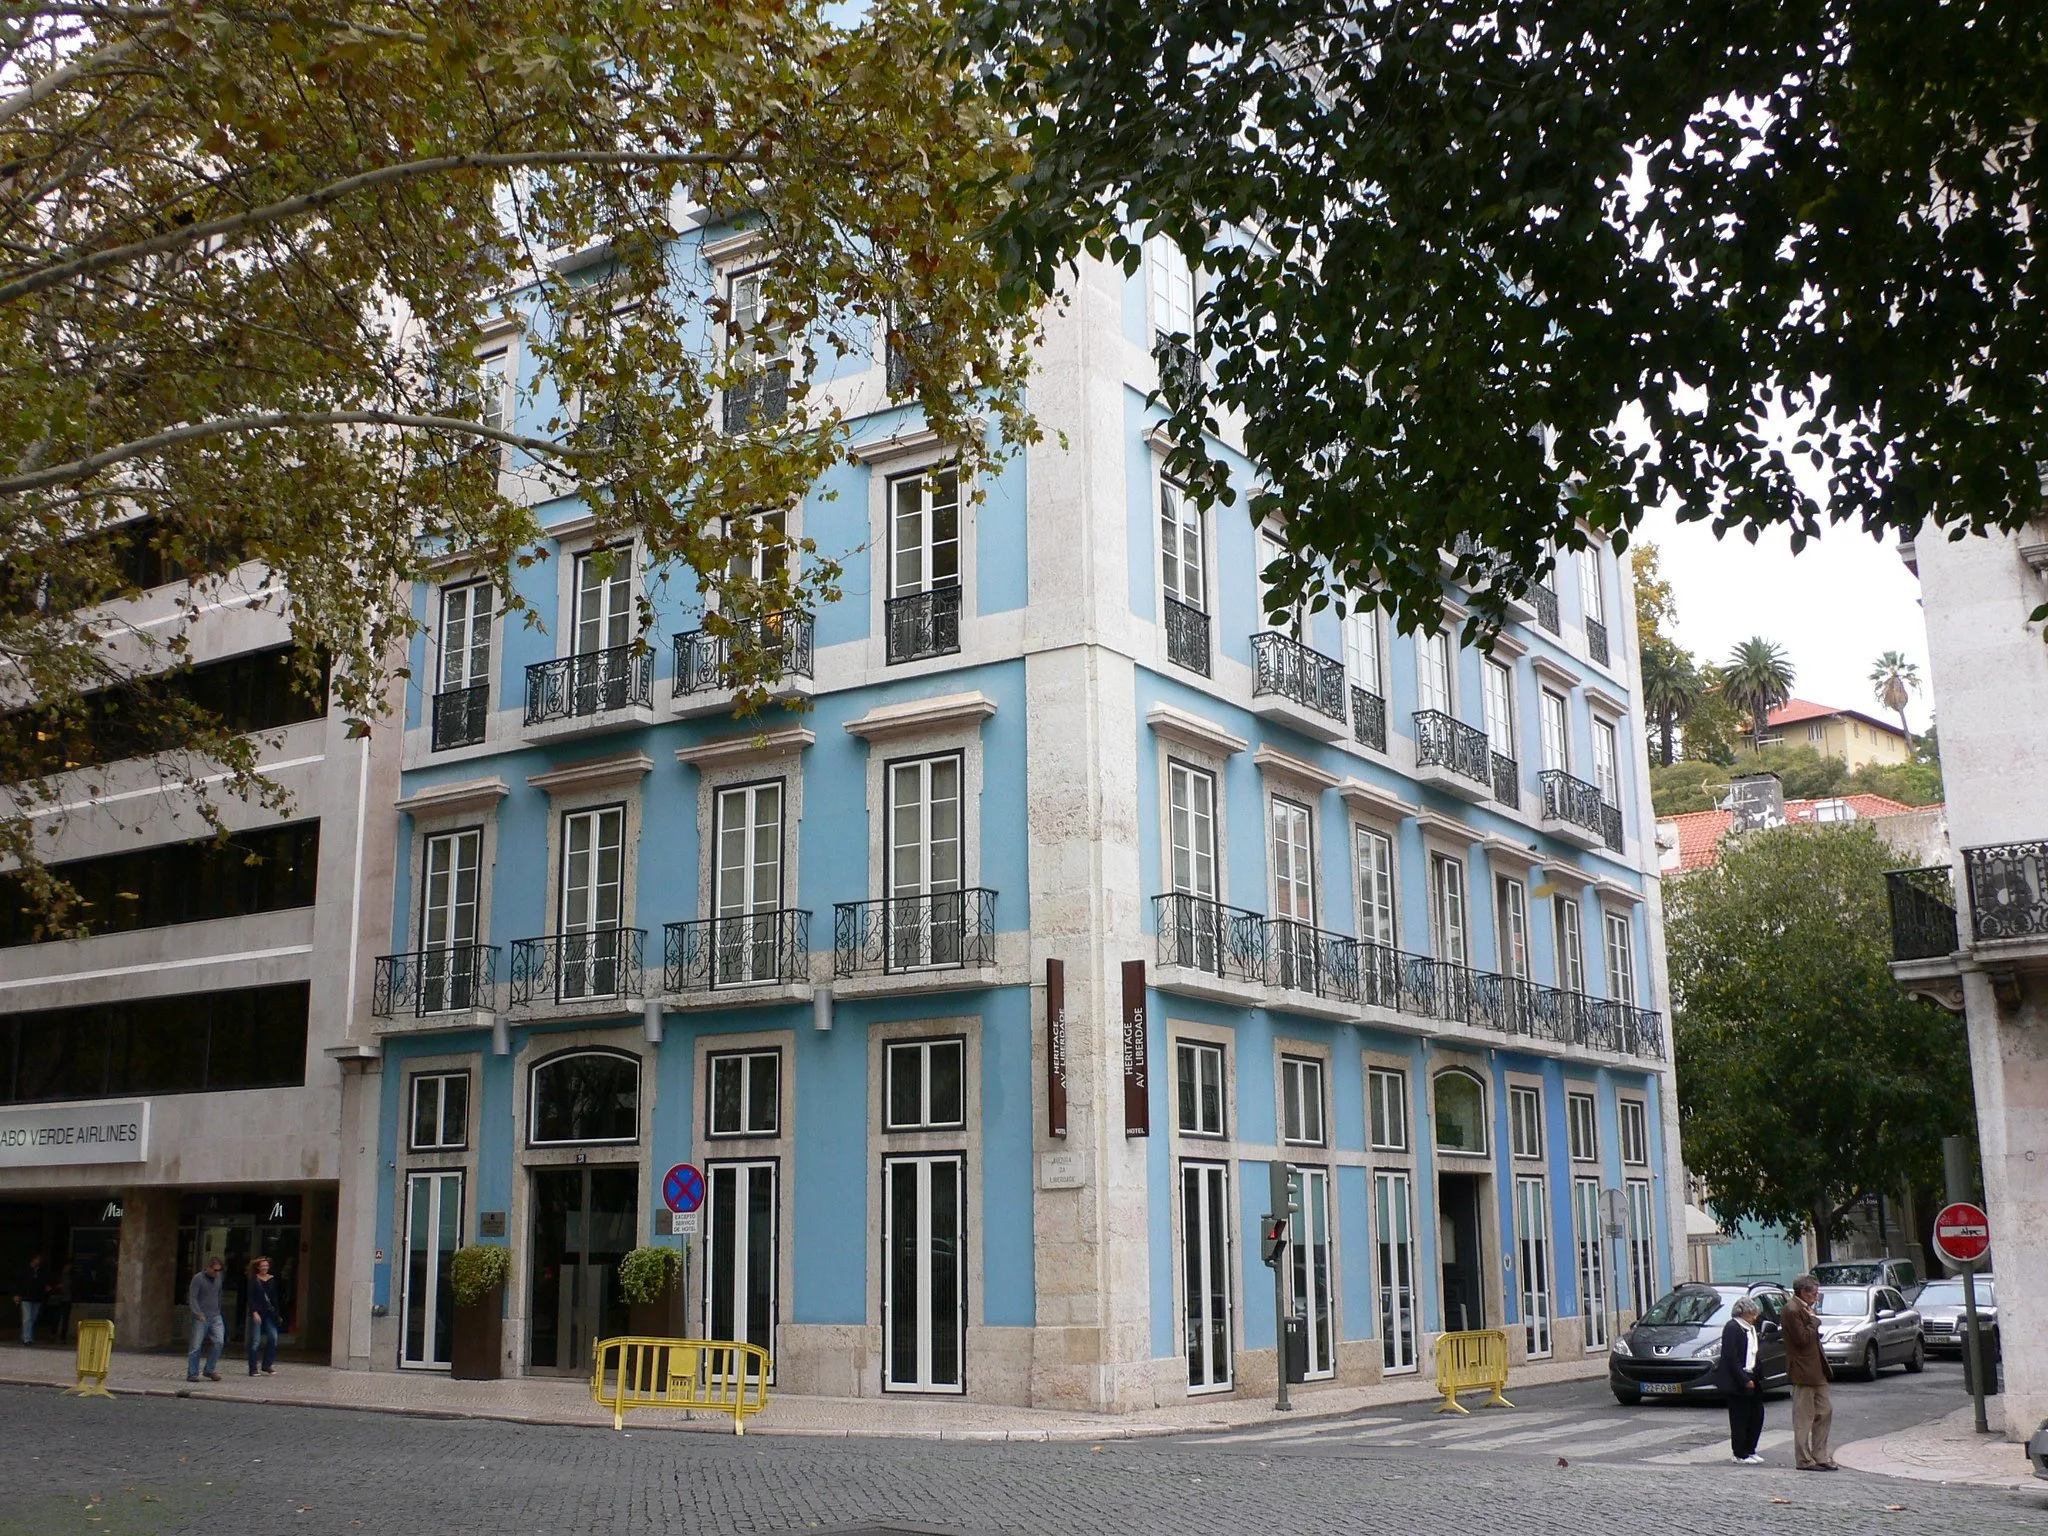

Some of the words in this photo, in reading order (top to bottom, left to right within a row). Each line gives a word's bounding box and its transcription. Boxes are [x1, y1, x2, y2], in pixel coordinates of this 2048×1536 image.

[1052, 1020, 1060, 1074] HERITAGE
[1124, 1021, 1133, 1076] HERITAGE
[1134, 1007, 1144, 1066] LIBERDADE
[1060, 1072, 1066, 1089] AV
[1136, 1072, 1145, 1088] AV
[30, 1127, 74, 1146] VERDE
[76, 1123, 138, 1144] AIRLINES
